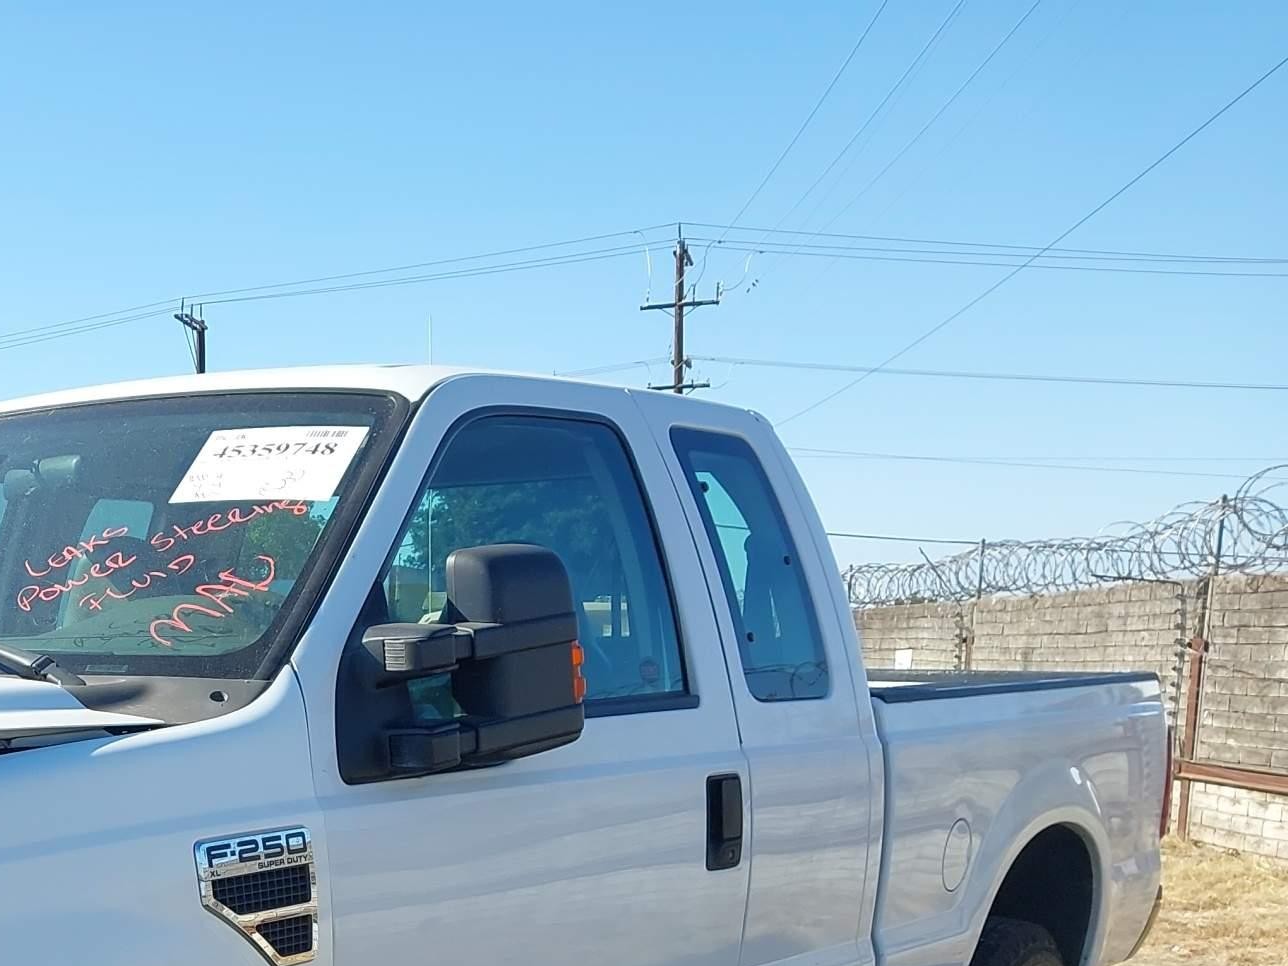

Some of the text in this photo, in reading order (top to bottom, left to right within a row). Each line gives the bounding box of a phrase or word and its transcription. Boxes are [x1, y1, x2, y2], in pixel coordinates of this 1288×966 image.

[212, 441, 338, 459] 45359748
[205, 831, 308, 868] F-250
[258, 855, 307, 868] SUPER DUTY
